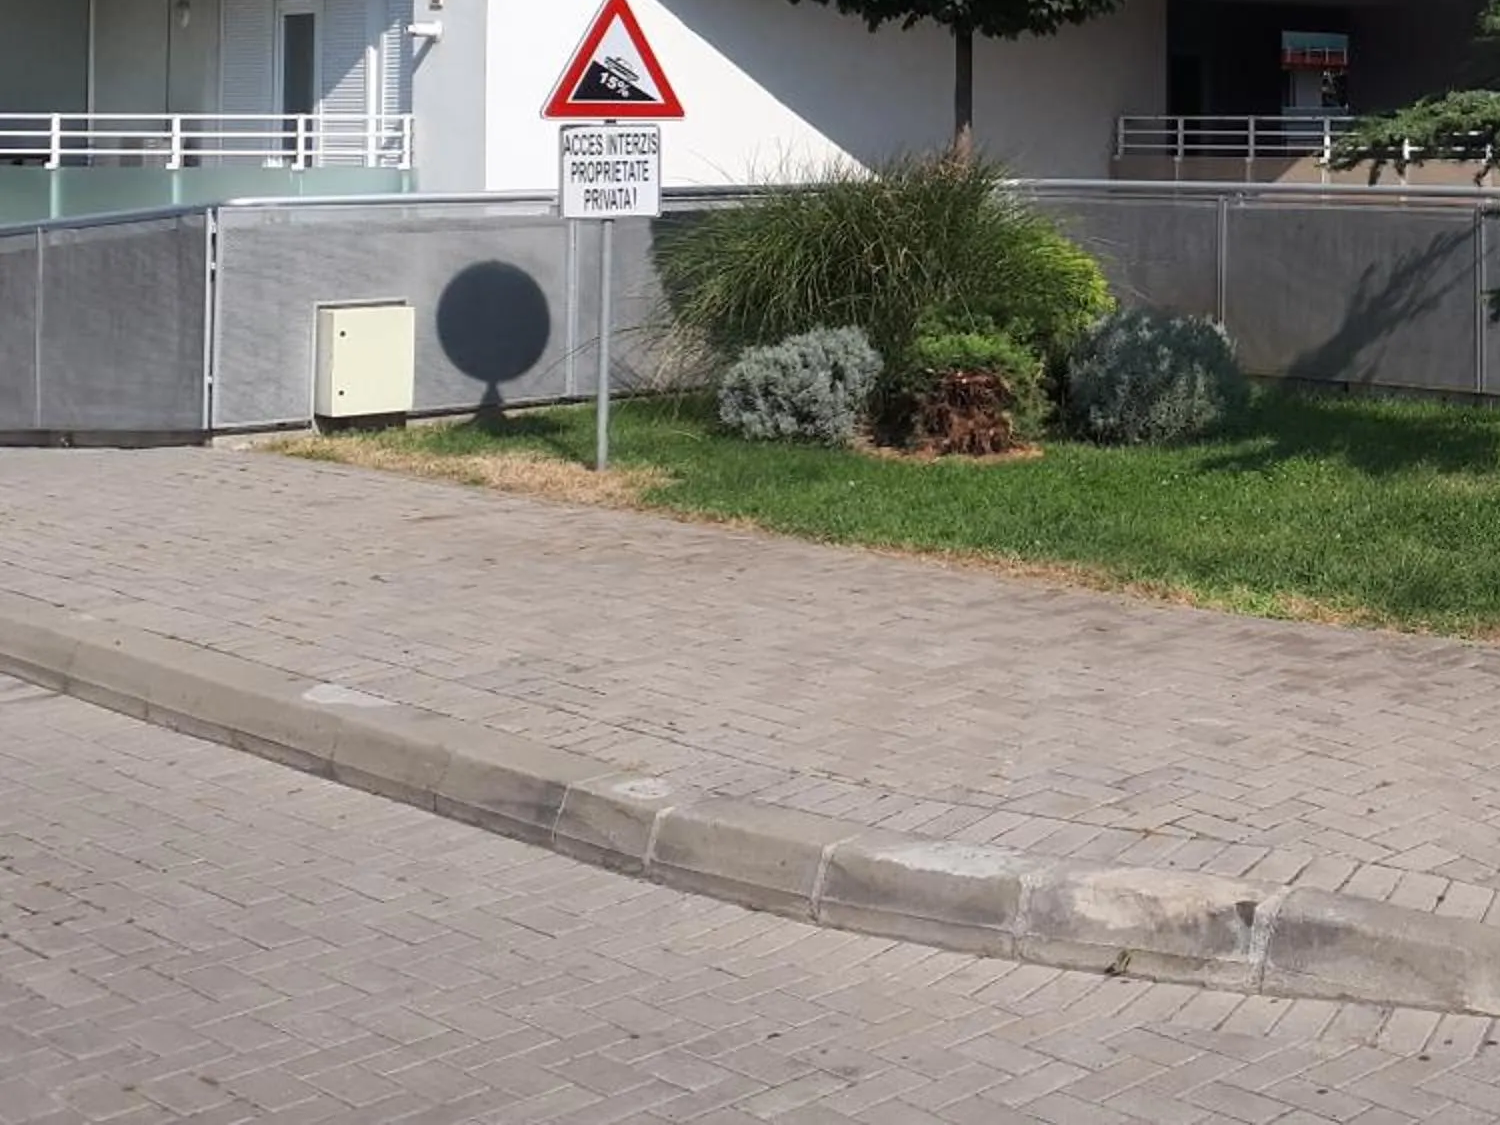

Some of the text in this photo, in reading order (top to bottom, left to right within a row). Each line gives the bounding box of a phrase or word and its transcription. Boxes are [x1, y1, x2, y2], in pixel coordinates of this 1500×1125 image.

[599, 71, 630, 98] 15%
[563, 132, 657, 156] ACCES INTERZIS
[570, 160, 649, 184] PROPRIETATE
